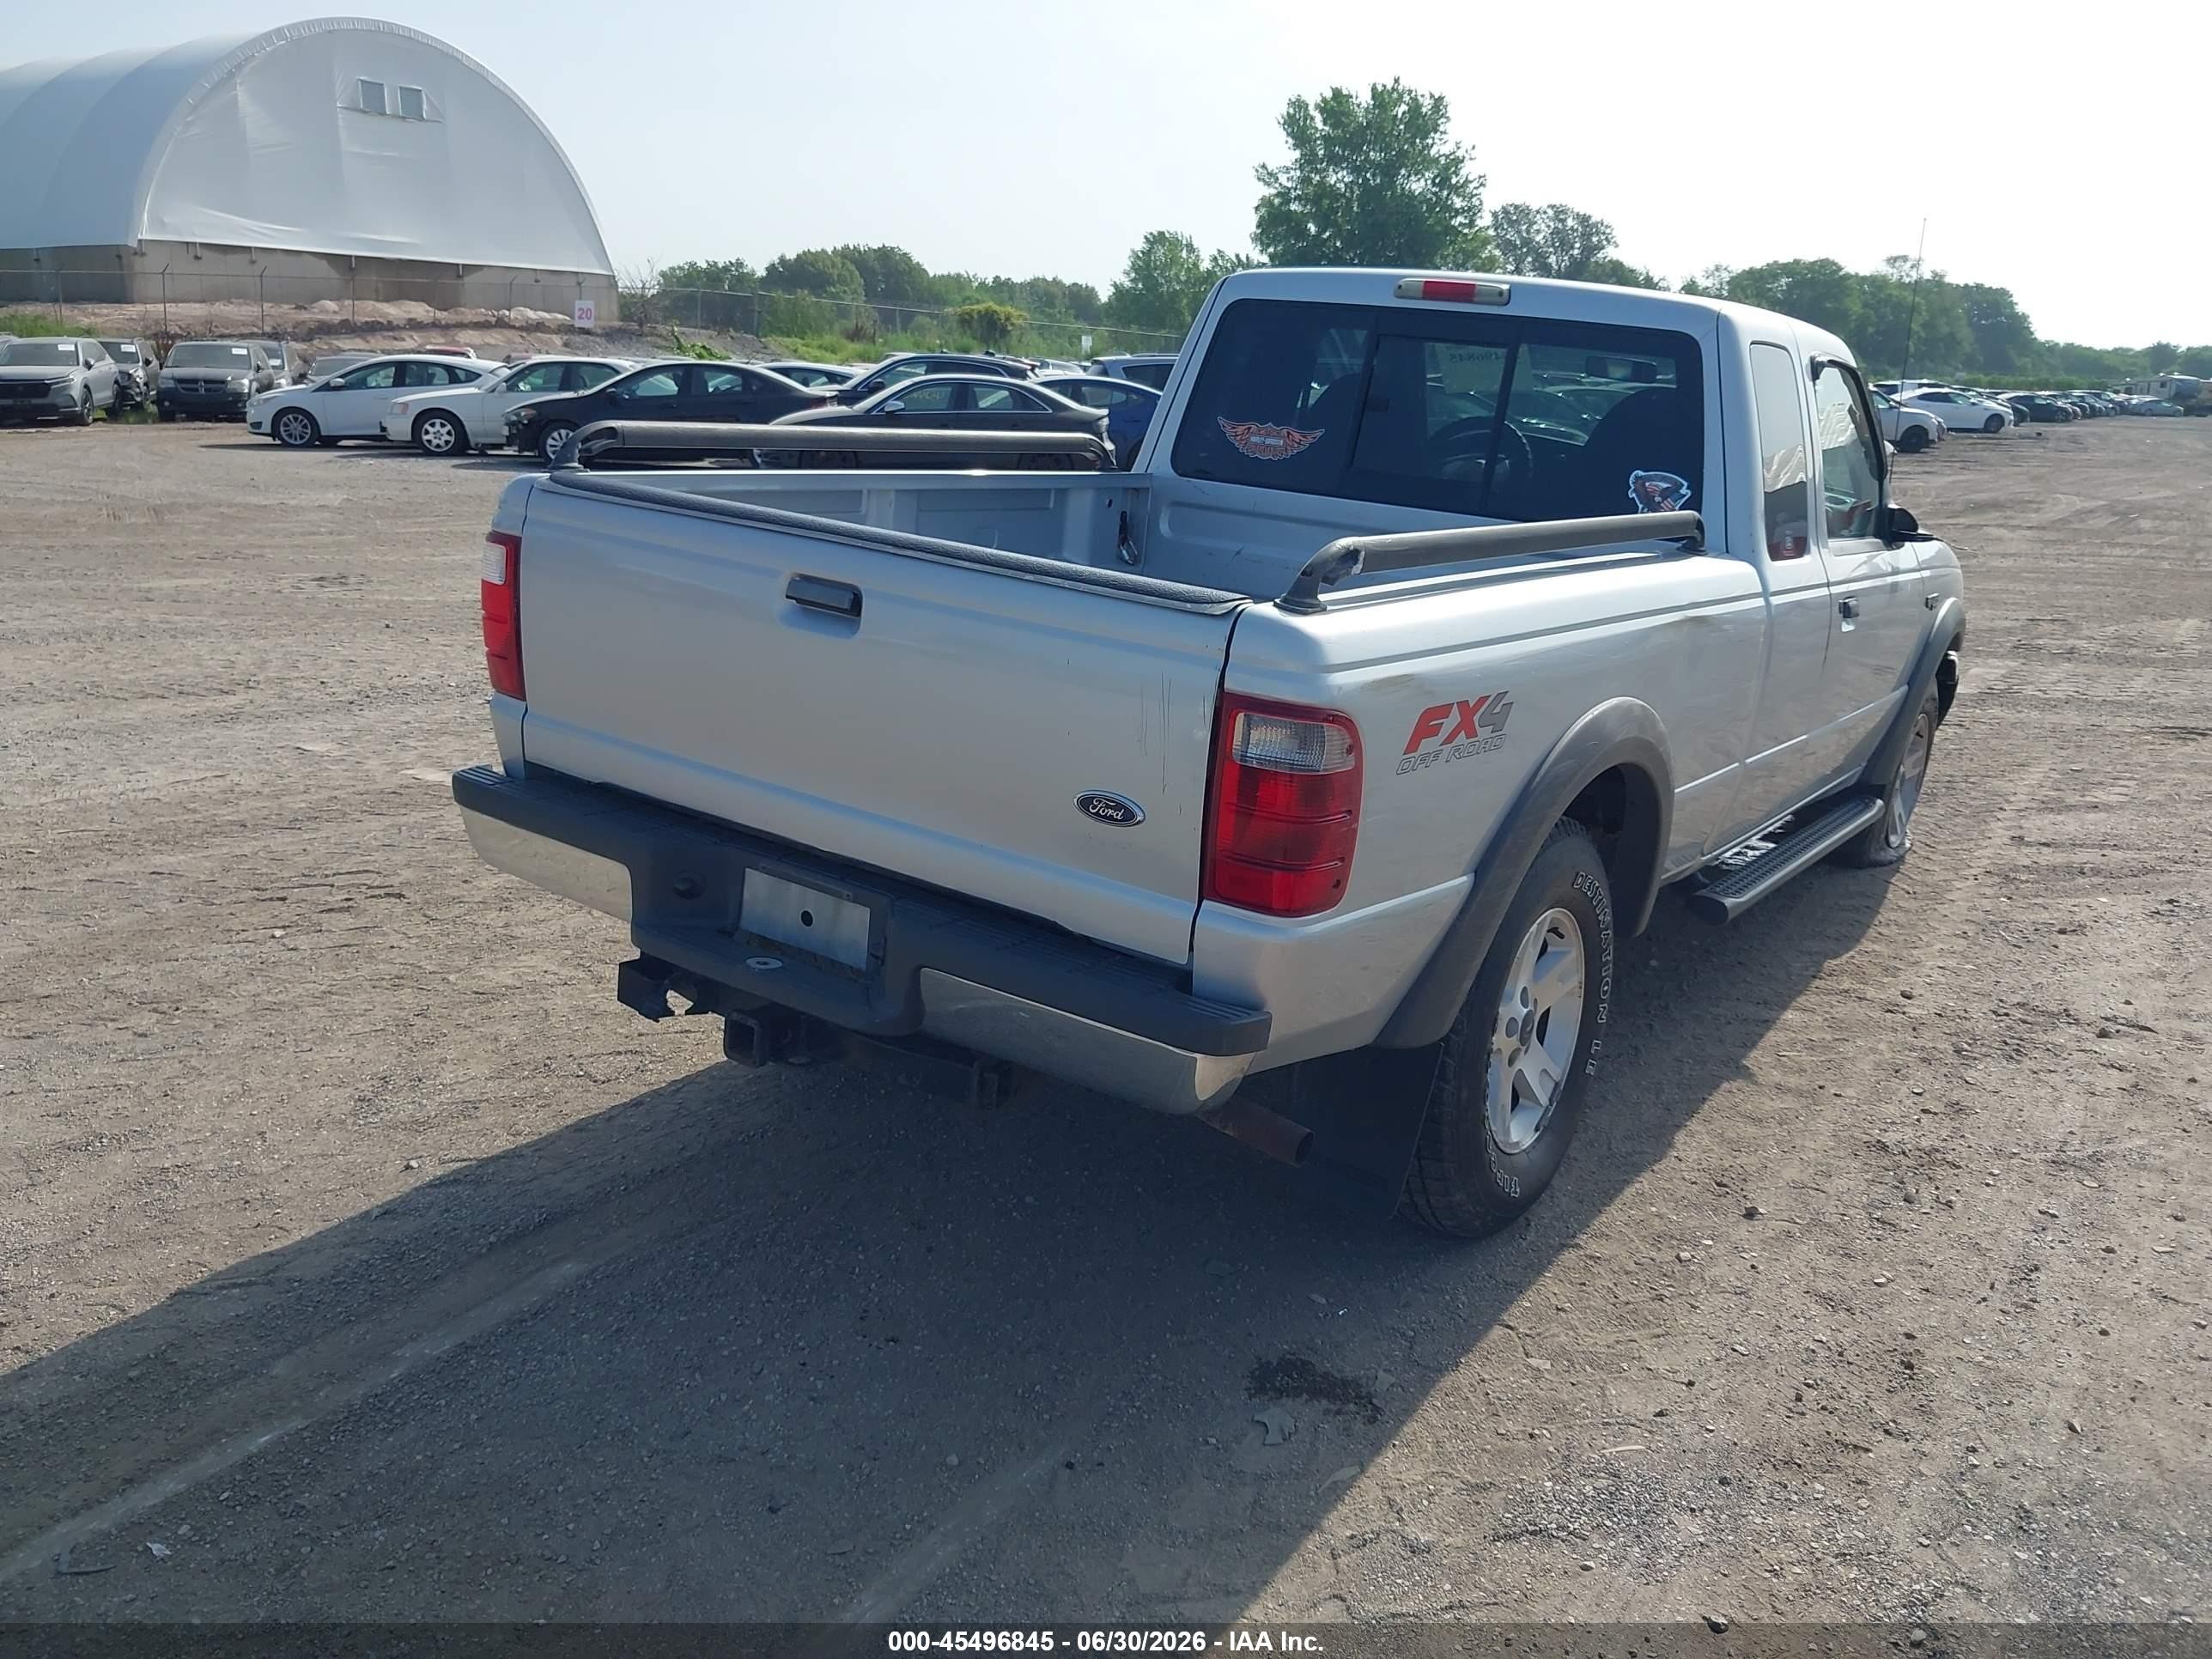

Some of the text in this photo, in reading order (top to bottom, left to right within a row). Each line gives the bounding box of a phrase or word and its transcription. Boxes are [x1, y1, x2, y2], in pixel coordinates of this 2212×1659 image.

[577, 307, 592, 320] 20
[1403, 690, 1514, 756] FX4
[1396, 734, 1507, 775] OFF ROAD
[1089, 798, 1125, 820] Ford
[1573, 872, 1613, 1024] DESTINATION
